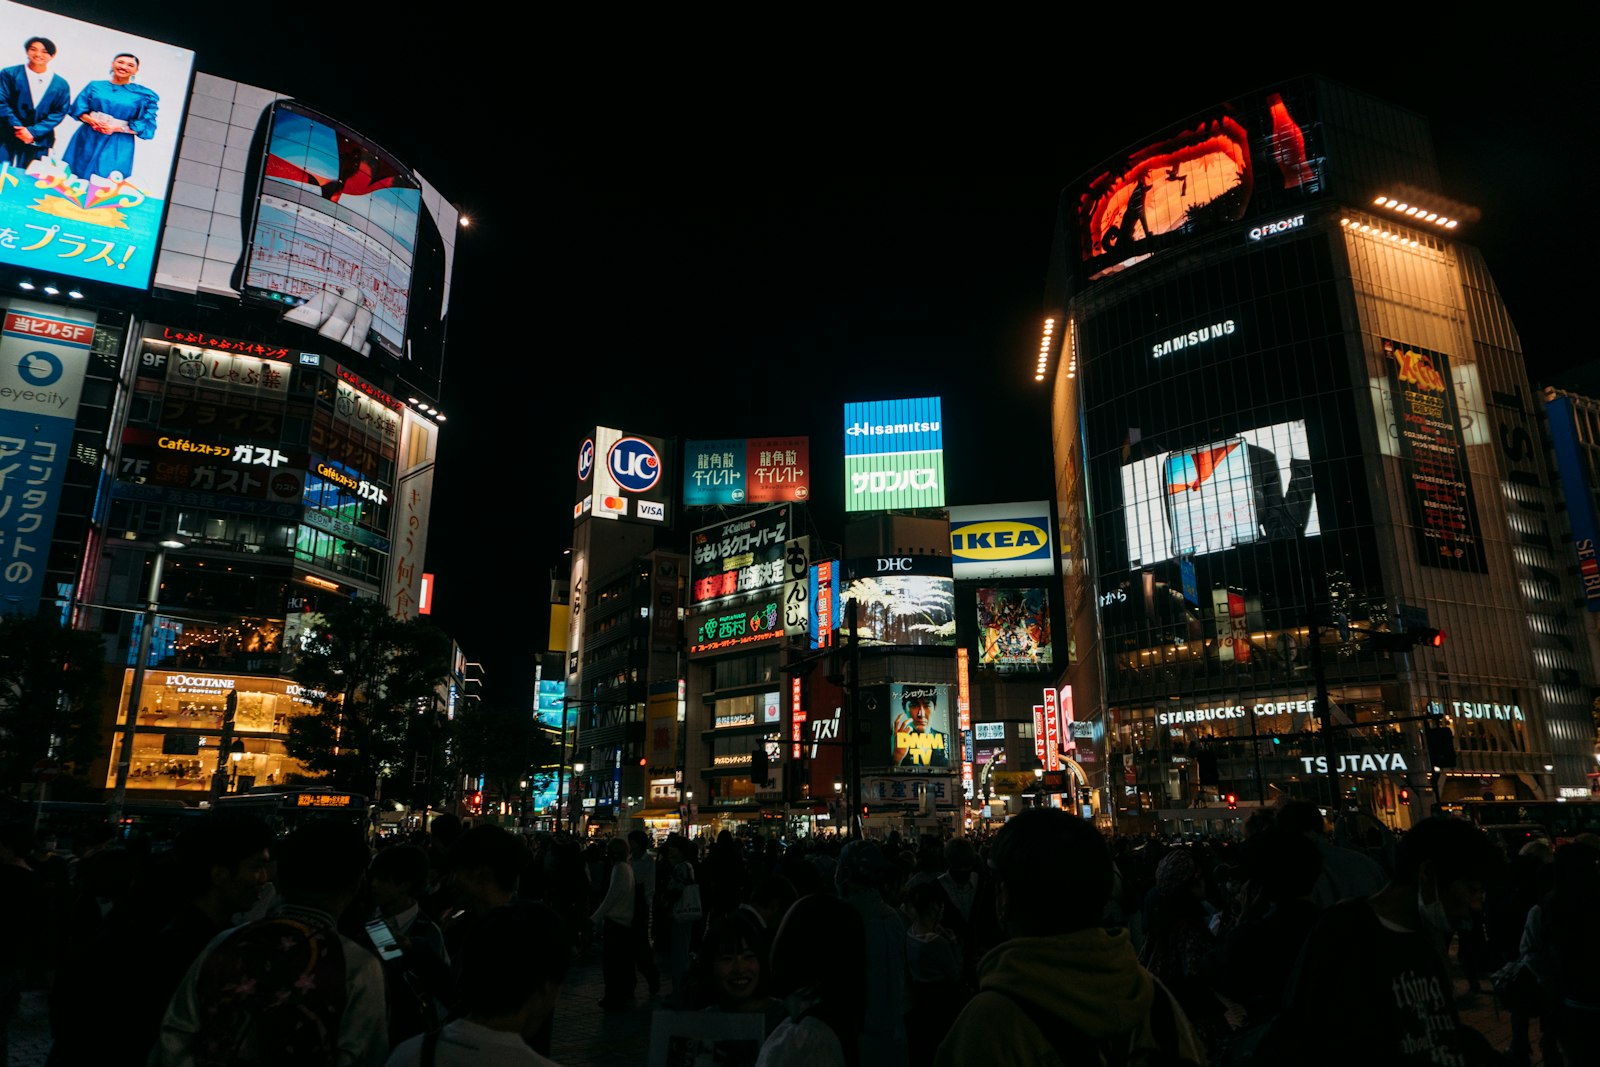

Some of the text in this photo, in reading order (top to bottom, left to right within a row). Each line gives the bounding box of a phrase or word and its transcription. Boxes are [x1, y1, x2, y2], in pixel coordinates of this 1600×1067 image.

[14, 317, 86, 341] 当ビル5F
[1152, 319, 1236, 359] SAMSUNG
[163, 326, 289, 359] しゃぶしゃぶバイキング
[143, 352, 166, 368] 9F
[212, 360, 282, 390] しゃぶ葉
[1, 387, 69, 409] eyecity
[336, 363, 402, 411] しゃぶしゃぶバイキング
[356, 402, 396, 437] しゃぶ葉
[846, 421, 940, 436] Hisamitsu
[121, 456, 150, 474] 7F
[232, 444, 289, 468] ガスト
[698, 452, 734, 469] 龍角散
[760, 450, 797, 466] 龍角散
[190, 466, 262, 494] ガスト
[692, 469, 740, 486] ダイレクト
[754, 467, 804, 483] ダイレクト
[852, 468, 937, 494] サロンパス
[357, 480, 388, 506] ガスト
[4, 441, 58, 584] コンタクトの
[641, 504, 662, 517] VISA
[694, 523, 786, 565] ももいろクローバーZ
[952, 530, 1040, 550] IKEA
[737, 559, 785, 592] 出演決定
[877, 558, 912, 571] DHC
[785, 541, 808, 631] もんじゃ
[719, 618, 747, 638] 西村
[166, 675, 235, 689] L'OCCITANE
[892, 687, 947, 701] ケンシロウによろしく
[1046, 694, 1057, 736] カラオケ
[1159, 699, 1317, 725] STARBUCKS COFFEE
[1452, 701, 1526, 722] TSUTAYA
[811, 706, 842, 760] クスリ
[896, 732, 944, 749] DMM
[910, 747, 932, 765] TV
